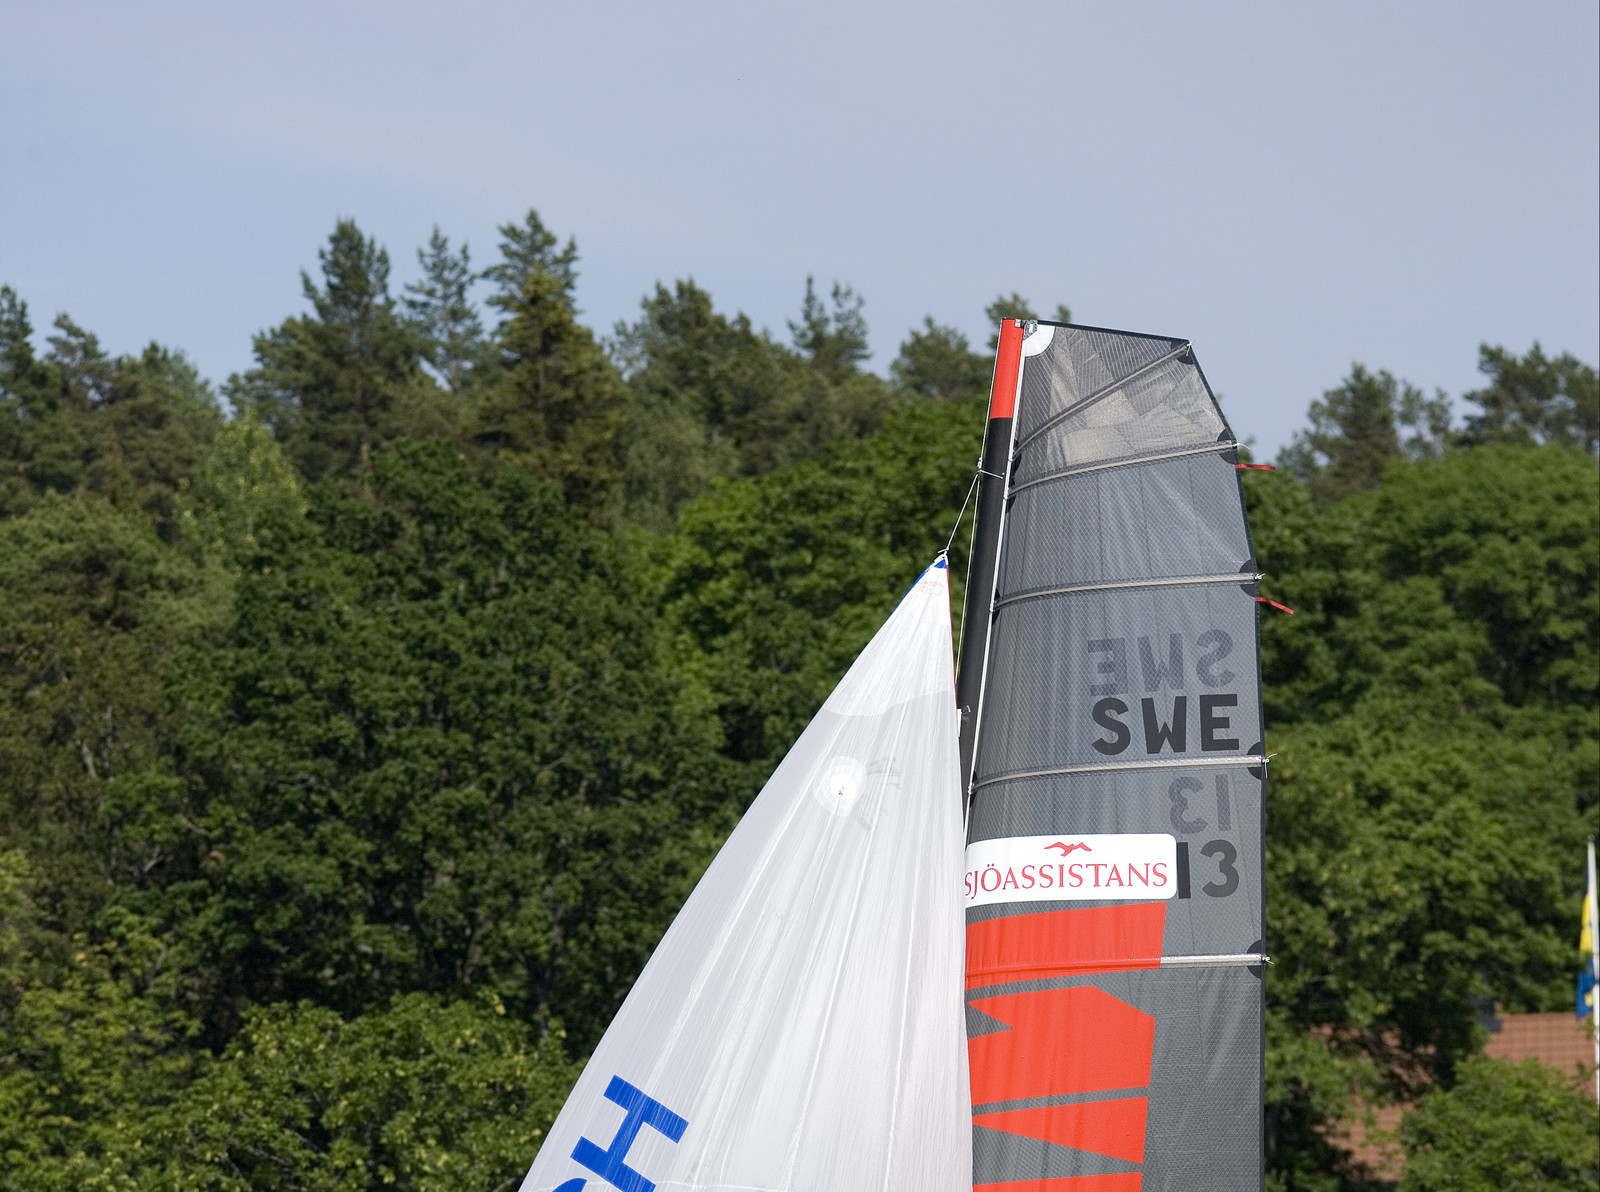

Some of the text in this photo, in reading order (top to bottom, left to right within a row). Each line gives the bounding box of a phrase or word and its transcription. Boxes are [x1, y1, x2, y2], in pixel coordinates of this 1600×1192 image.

[1091, 693, 1240, 755] SWE
[964, 862, 1168, 900] SJÖASSISTANS
[1176, 839, 1240, 900] 13
